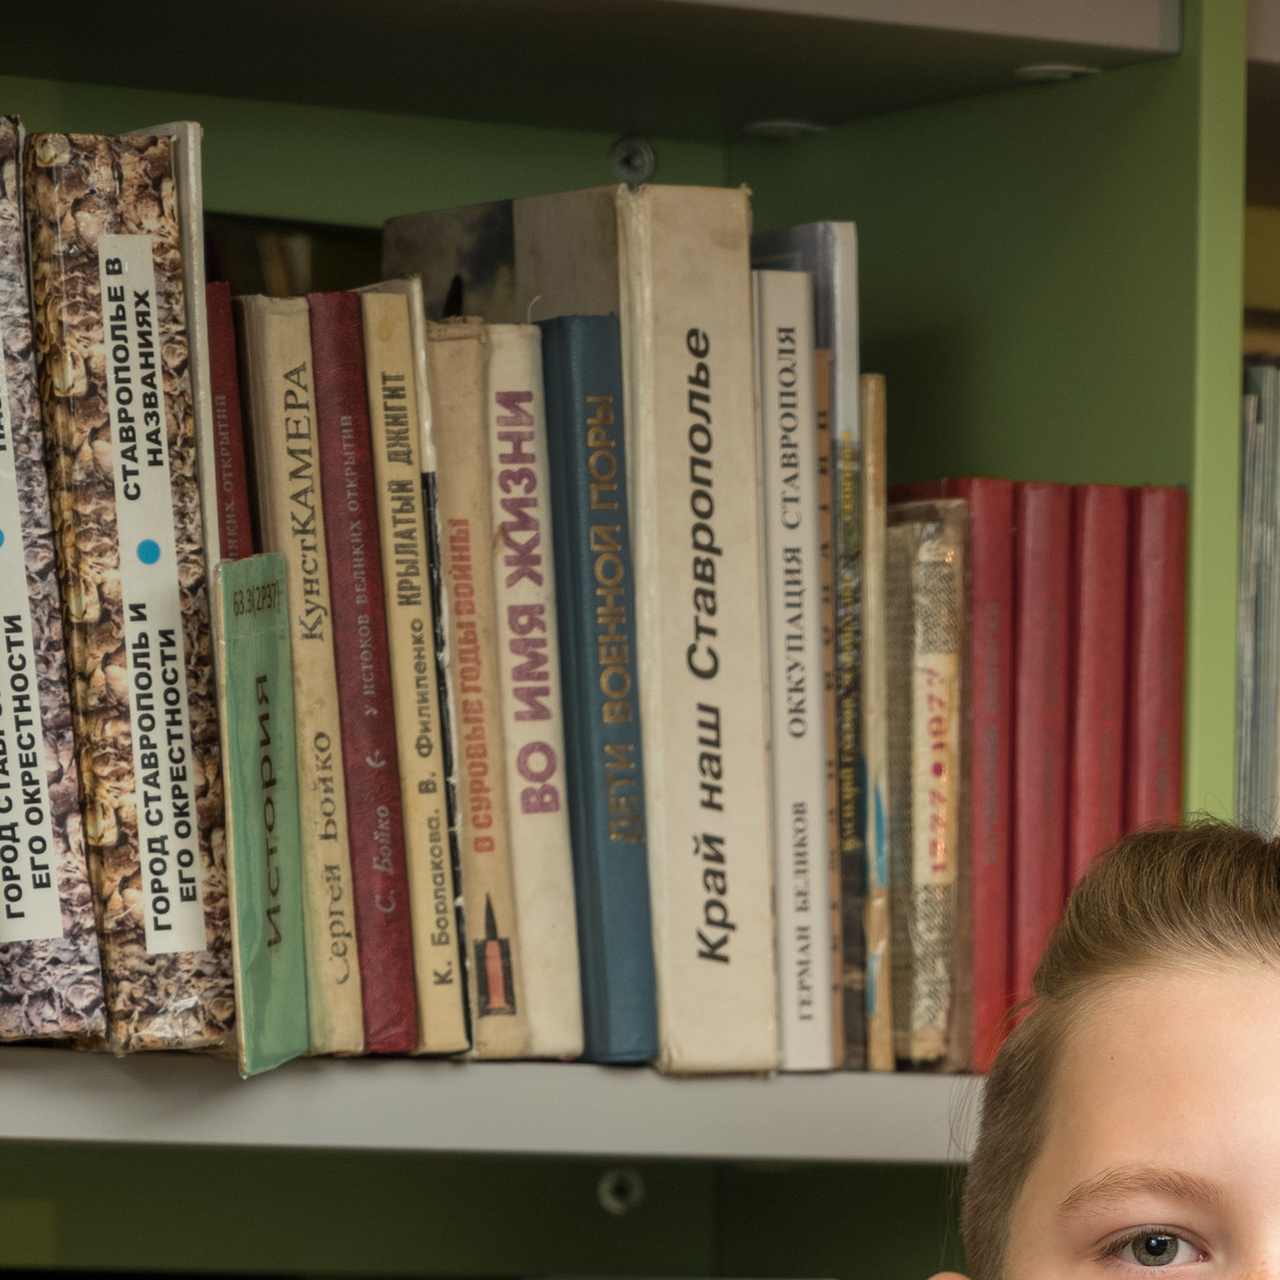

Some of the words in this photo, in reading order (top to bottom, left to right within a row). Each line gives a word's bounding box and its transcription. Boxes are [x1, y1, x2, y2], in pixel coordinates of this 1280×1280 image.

[105, 257, 122, 275] В
[107, 285, 140, 500] СТАВРОПОЛЬЕ
[133, 290, 163, 466] НАЗВАНИЯХ
[380, 371, 413, 465] ДЖИГИТ
[776, 326, 799, 529] СТАВРОПОЛЯ
[495, 389, 543, 587] ЖИЗНИ
[586, 396, 618, 509] ПОРЫ
[685, 327, 722, 679] Ставрополье
[387, 479, 421, 605] КРЫЛАТЫЙ
[128, 603, 147, 621] И
[454, 620, 481, 693] ГОДЫ
[507, 603, 551, 720] ИМЯ
[590, 525, 632, 726] ВОЕННОЙ
[783, 547, 804, 738] ОККУПАЦИЯ
[3, 614, 43, 825] ОКРЕСТНОСТИ
[131, 631, 163, 826] СТАВРОПОЛЬ
[158, 628, 191, 838] ОКРЕСТНОСТИ
[410, 617, 433, 758] Филипенко
[255, 673, 281, 948] История
[417, 771, 437, 794] В.
[460, 698, 492, 829] СУРОВЫЕ
[517, 741, 560, 813] ВО
[603, 743, 641, 843] ДЕТИ
[697, 703, 722, 811] наш
[28, 835, 51, 889] ЕГО
[147, 834, 171, 930] ГОРОД
[176, 848, 196, 901] ЕГО
[370, 804, 393, 876] Бойко
[427, 809, 450, 945] Борлакова.
[693, 833, 735, 963] Край
[792, 801, 809, 912] БЕЛИКОВ
[432, 961, 453, 985] К.
[796, 925, 812, 1020] ГЕРМАН
